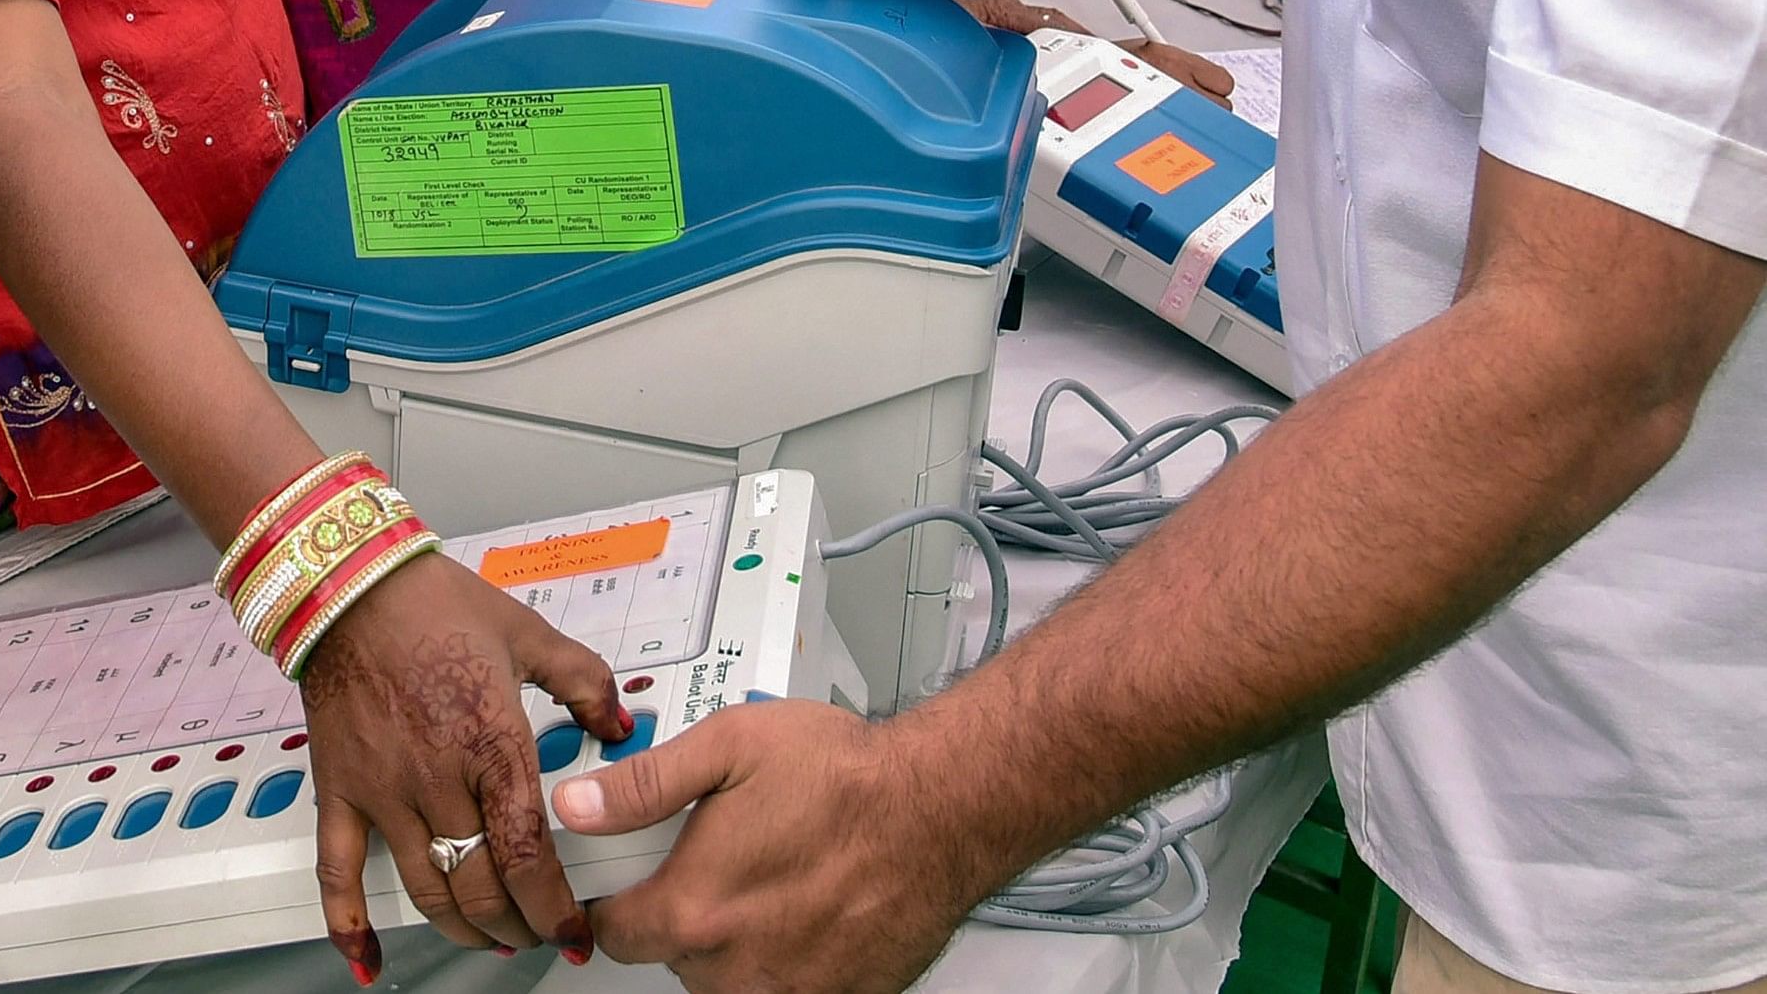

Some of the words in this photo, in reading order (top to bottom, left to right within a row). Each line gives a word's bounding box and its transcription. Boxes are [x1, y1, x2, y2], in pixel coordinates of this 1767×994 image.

[419, 101, 440, 109] Union
[352, 115, 374, 123] Name
[382, 113, 395, 121] the
[353, 125, 381, 133] District
[381, 125, 402, 133] Name
[487, 130, 514, 138] District
[383, 135, 399, 143] Unit
[486, 139, 517, 148] Running
[381, 142, 440, 162] 32949
[486, 147, 507, 155] Serial
[490, 157, 518, 165] Current
[423, 182, 440, 190] First
[441, 181, 461, 189] Level
[462, 180, 485, 188] Check
[575, 176, 587, 184] CU
[371, 194, 388, 202] Date
[743, 528, 761, 550] Ready
[518, 536, 605, 557] TRAINING
[501, 553, 609, 579] AWARENESS
[190, 600, 211, 610] 9
[130, 607, 154, 623] 10
[65, 619, 90, 634] 11
[9, 630, 33, 646] 12
[687, 663, 709, 698] Ballot
[682, 700, 702, 725] Unit
